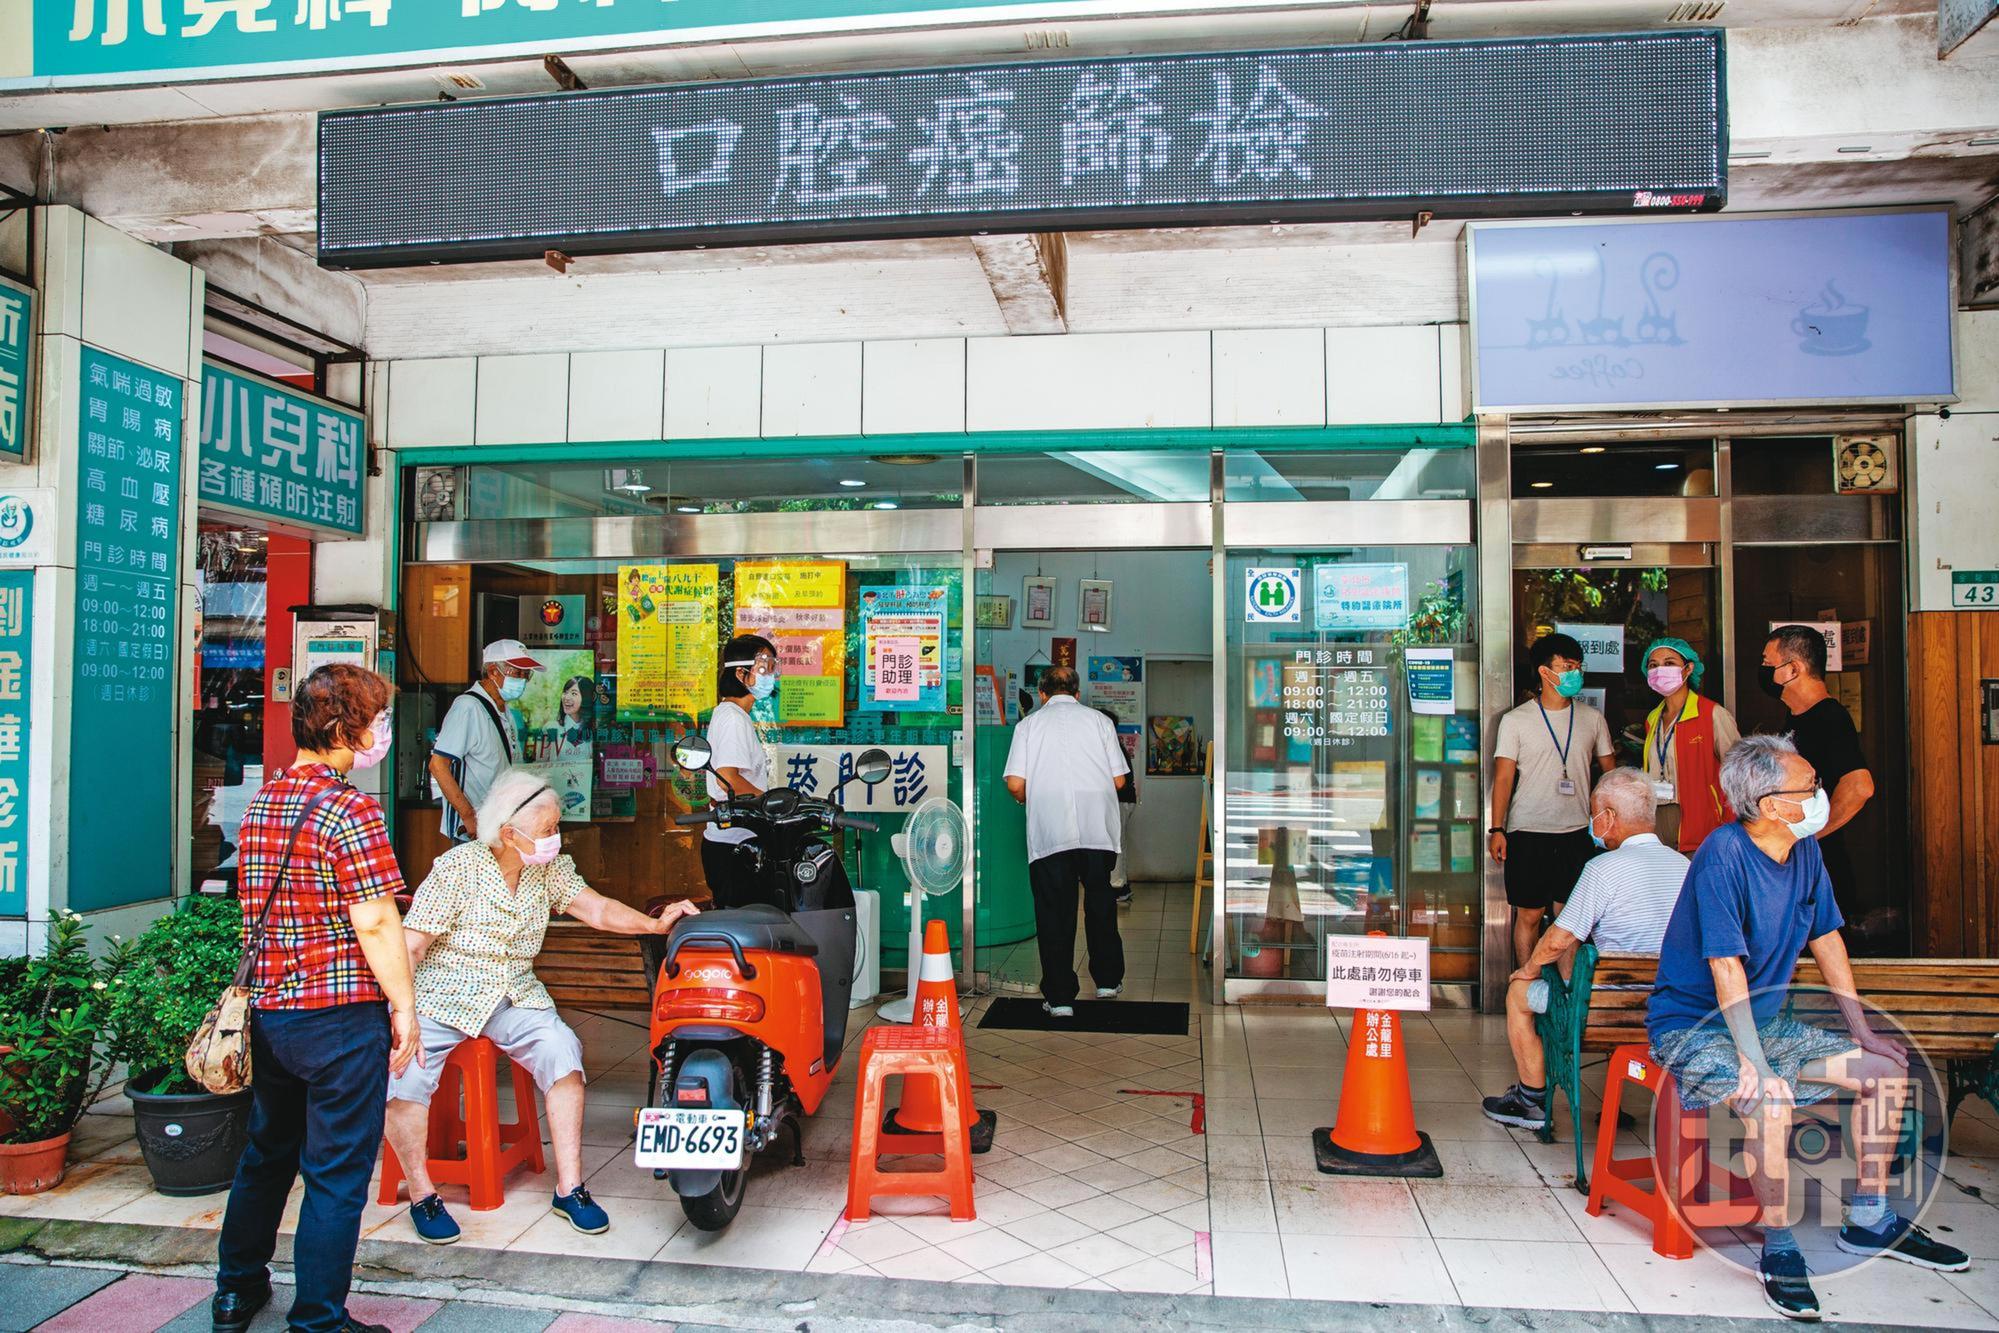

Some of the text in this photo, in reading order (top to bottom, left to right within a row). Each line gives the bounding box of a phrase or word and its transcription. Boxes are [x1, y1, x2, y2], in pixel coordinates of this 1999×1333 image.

[89, 361, 173, 409] 氣喘過敏
[200, 374, 358, 490] 小兒科
[200, 457, 356, 527] 各種預防注射
[84, 540, 167, 572] 門診時間
[1964, 586, 1994, 602] 43
[882, 654, 913, 669] 門診
[1295, 650, 1373, 664] 門診時間
[882, 670, 913, 684] 助理
[684, 968, 733, 982] gogoro
[1332, 965, 1423, 982] 此處請勿停車
[1369, 987, 1420, 997] 謝謝您的配合
[1381, 1013, 1392, 1057] 金龍里
